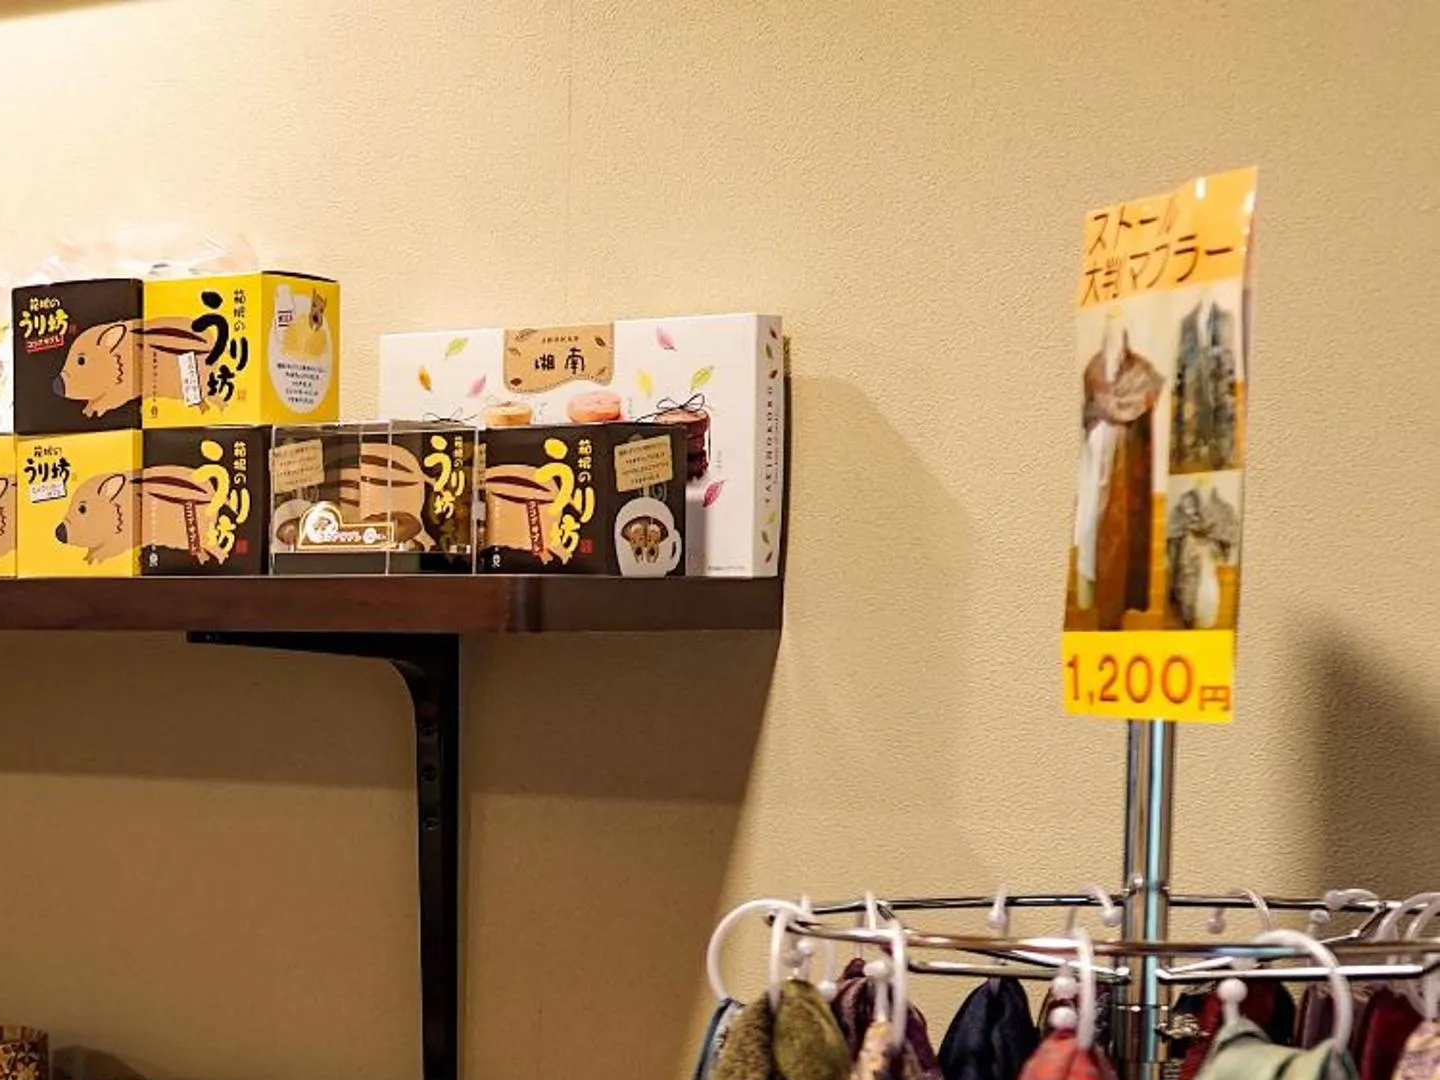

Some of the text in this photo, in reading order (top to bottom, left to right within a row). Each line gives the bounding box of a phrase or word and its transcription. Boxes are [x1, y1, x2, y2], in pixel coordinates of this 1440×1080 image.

[19, 309, 68, 338] うり坊
[193, 291, 248, 402] うり坊
[534, 347, 586, 375] 湘南
[24, 458, 71, 485] うり坊
[192, 440, 250, 559] うり坊
[536, 437, 595, 557] うり坊
[1065, 654, 1233, 712] 1,200円
